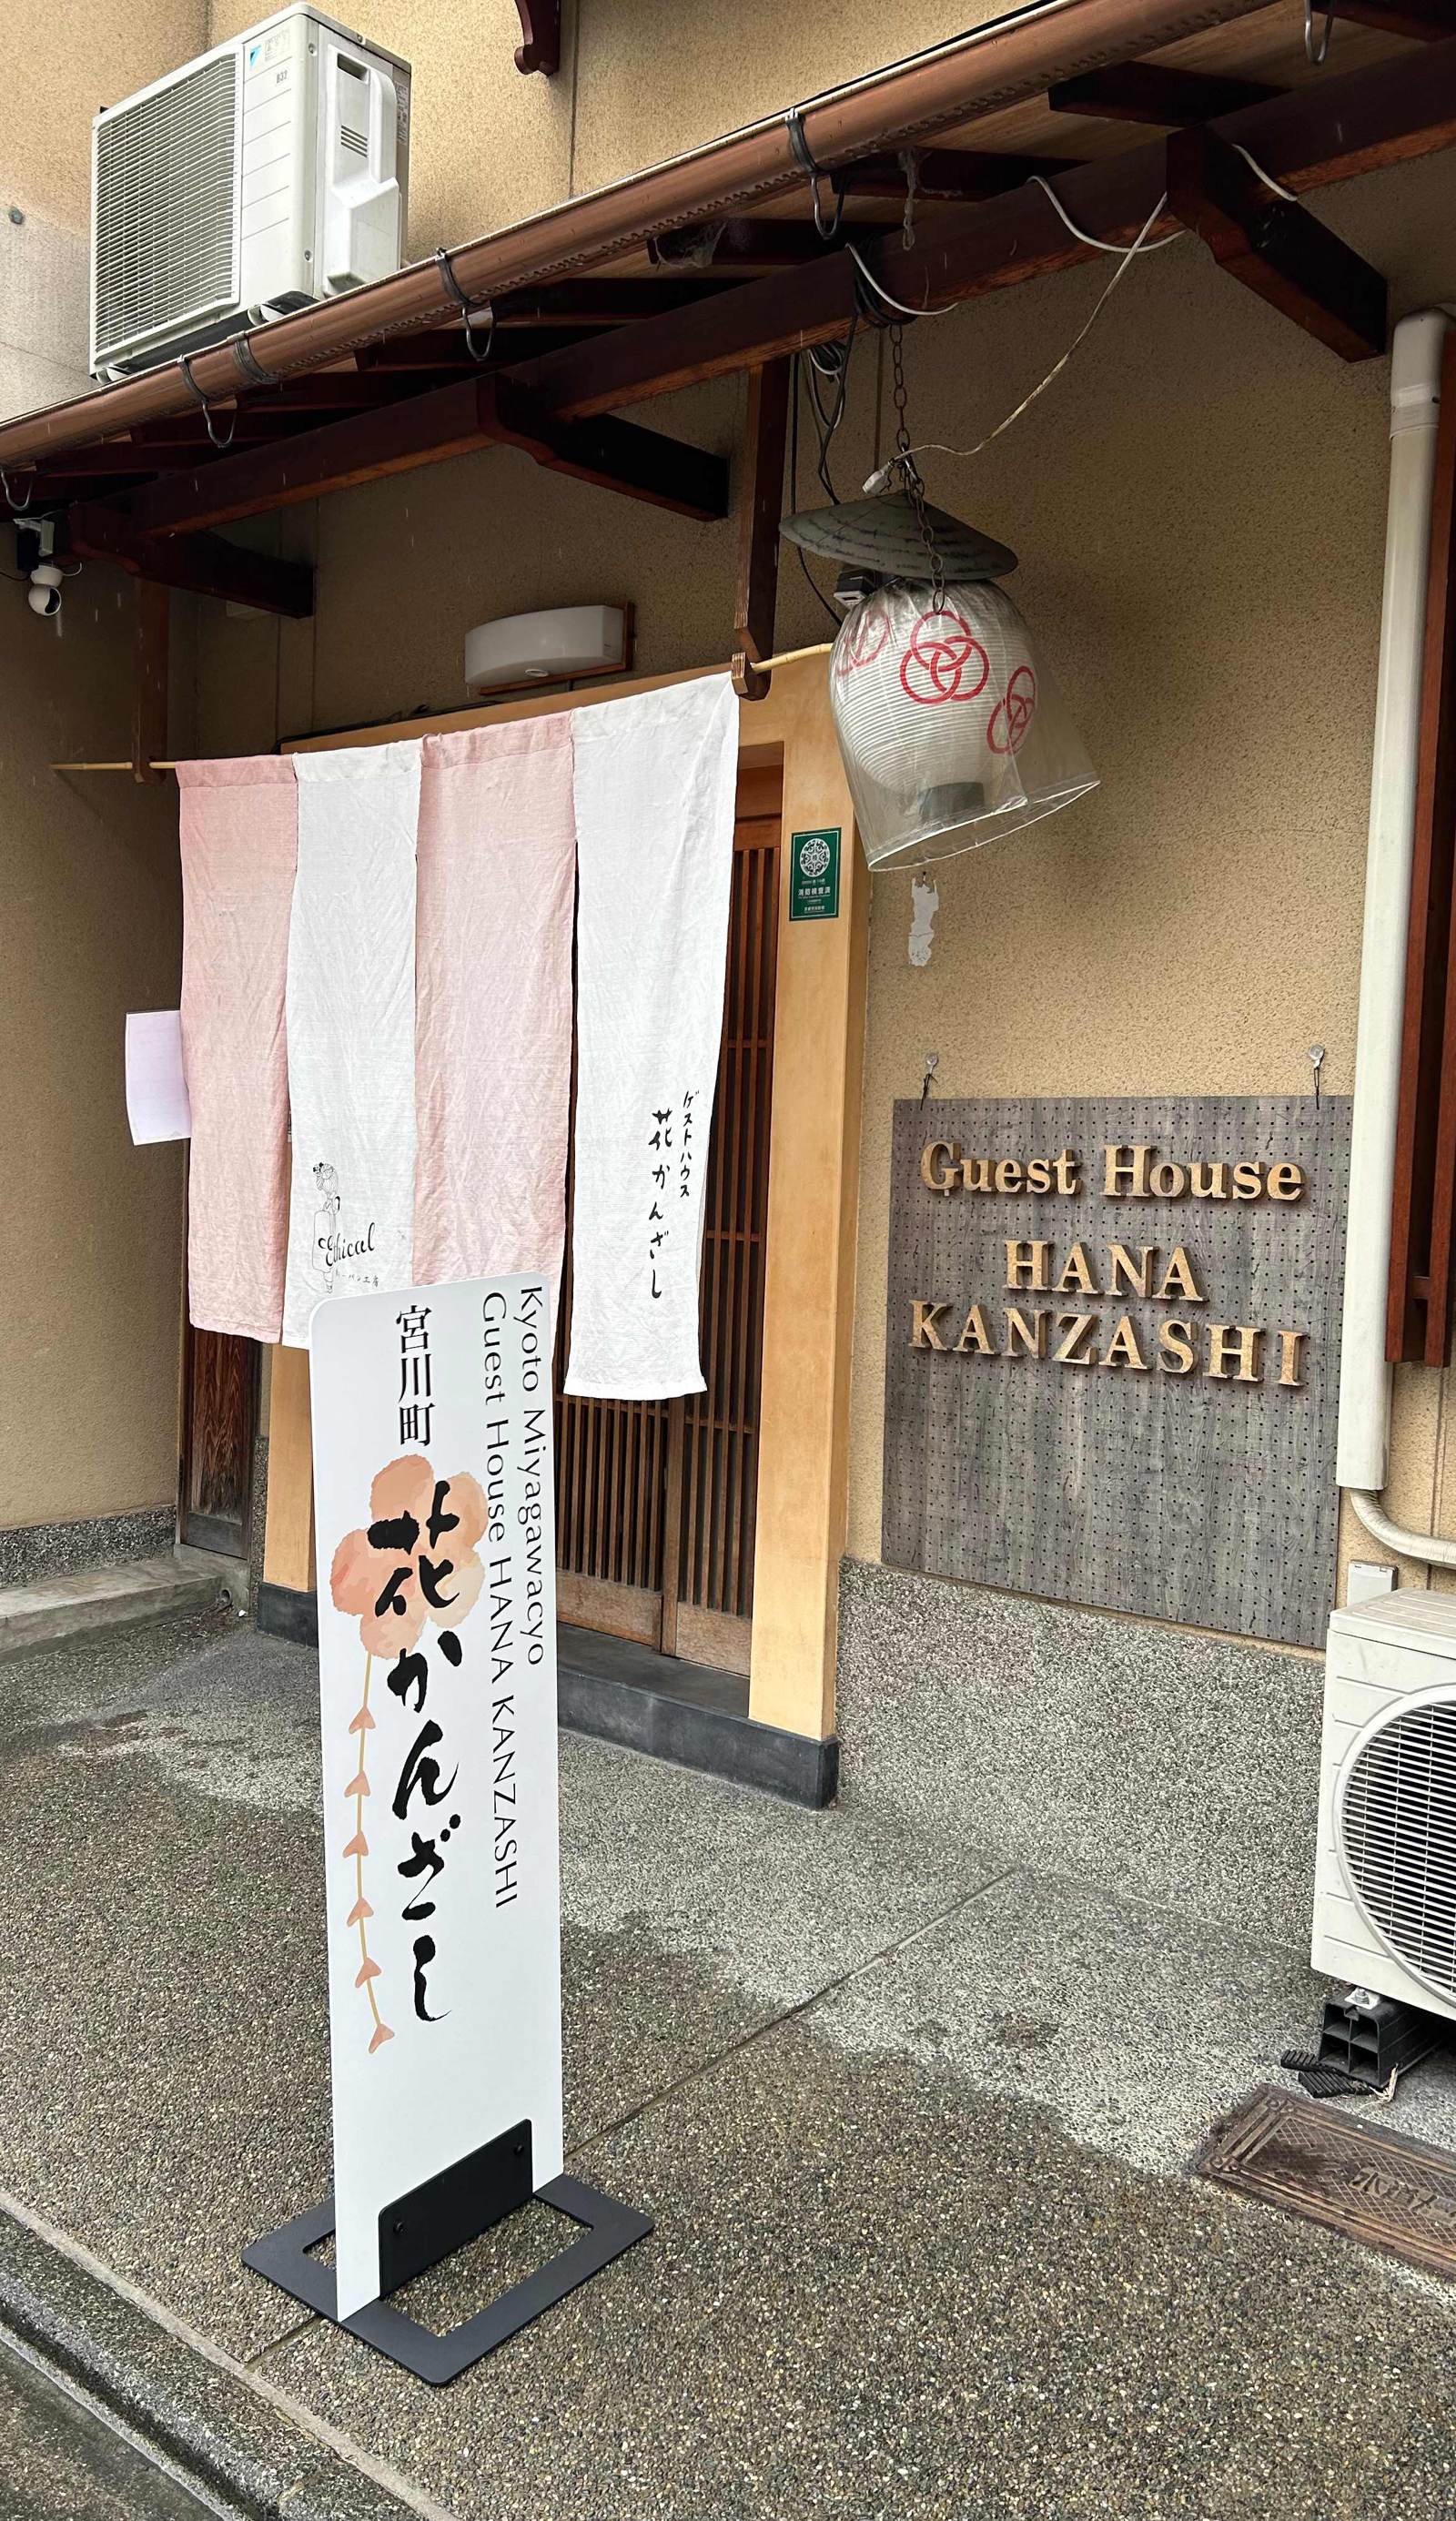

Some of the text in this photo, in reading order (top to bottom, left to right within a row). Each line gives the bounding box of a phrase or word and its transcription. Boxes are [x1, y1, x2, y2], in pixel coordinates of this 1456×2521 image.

[648, 1108, 673, 1299] 花かんざし
[681, 1090, 700, 1198] ゲストハウス
[921, 1141, 1308, 1201] Guest House
[318, 1222, 376, 1267] Ethical
[1003, 1239, 1209, 1302] HANA
[395, 1304, 436, 1447] 宮川町
[908, 1300, 1308, 1387] KANZASHI
[513, 1286, 547, 1665] Kyoto Miyagawacyo
[482, 1291, 518, 1908] Guest House HANA KANZASHI
[367, 1480, 463, 2022] 花かんざし
